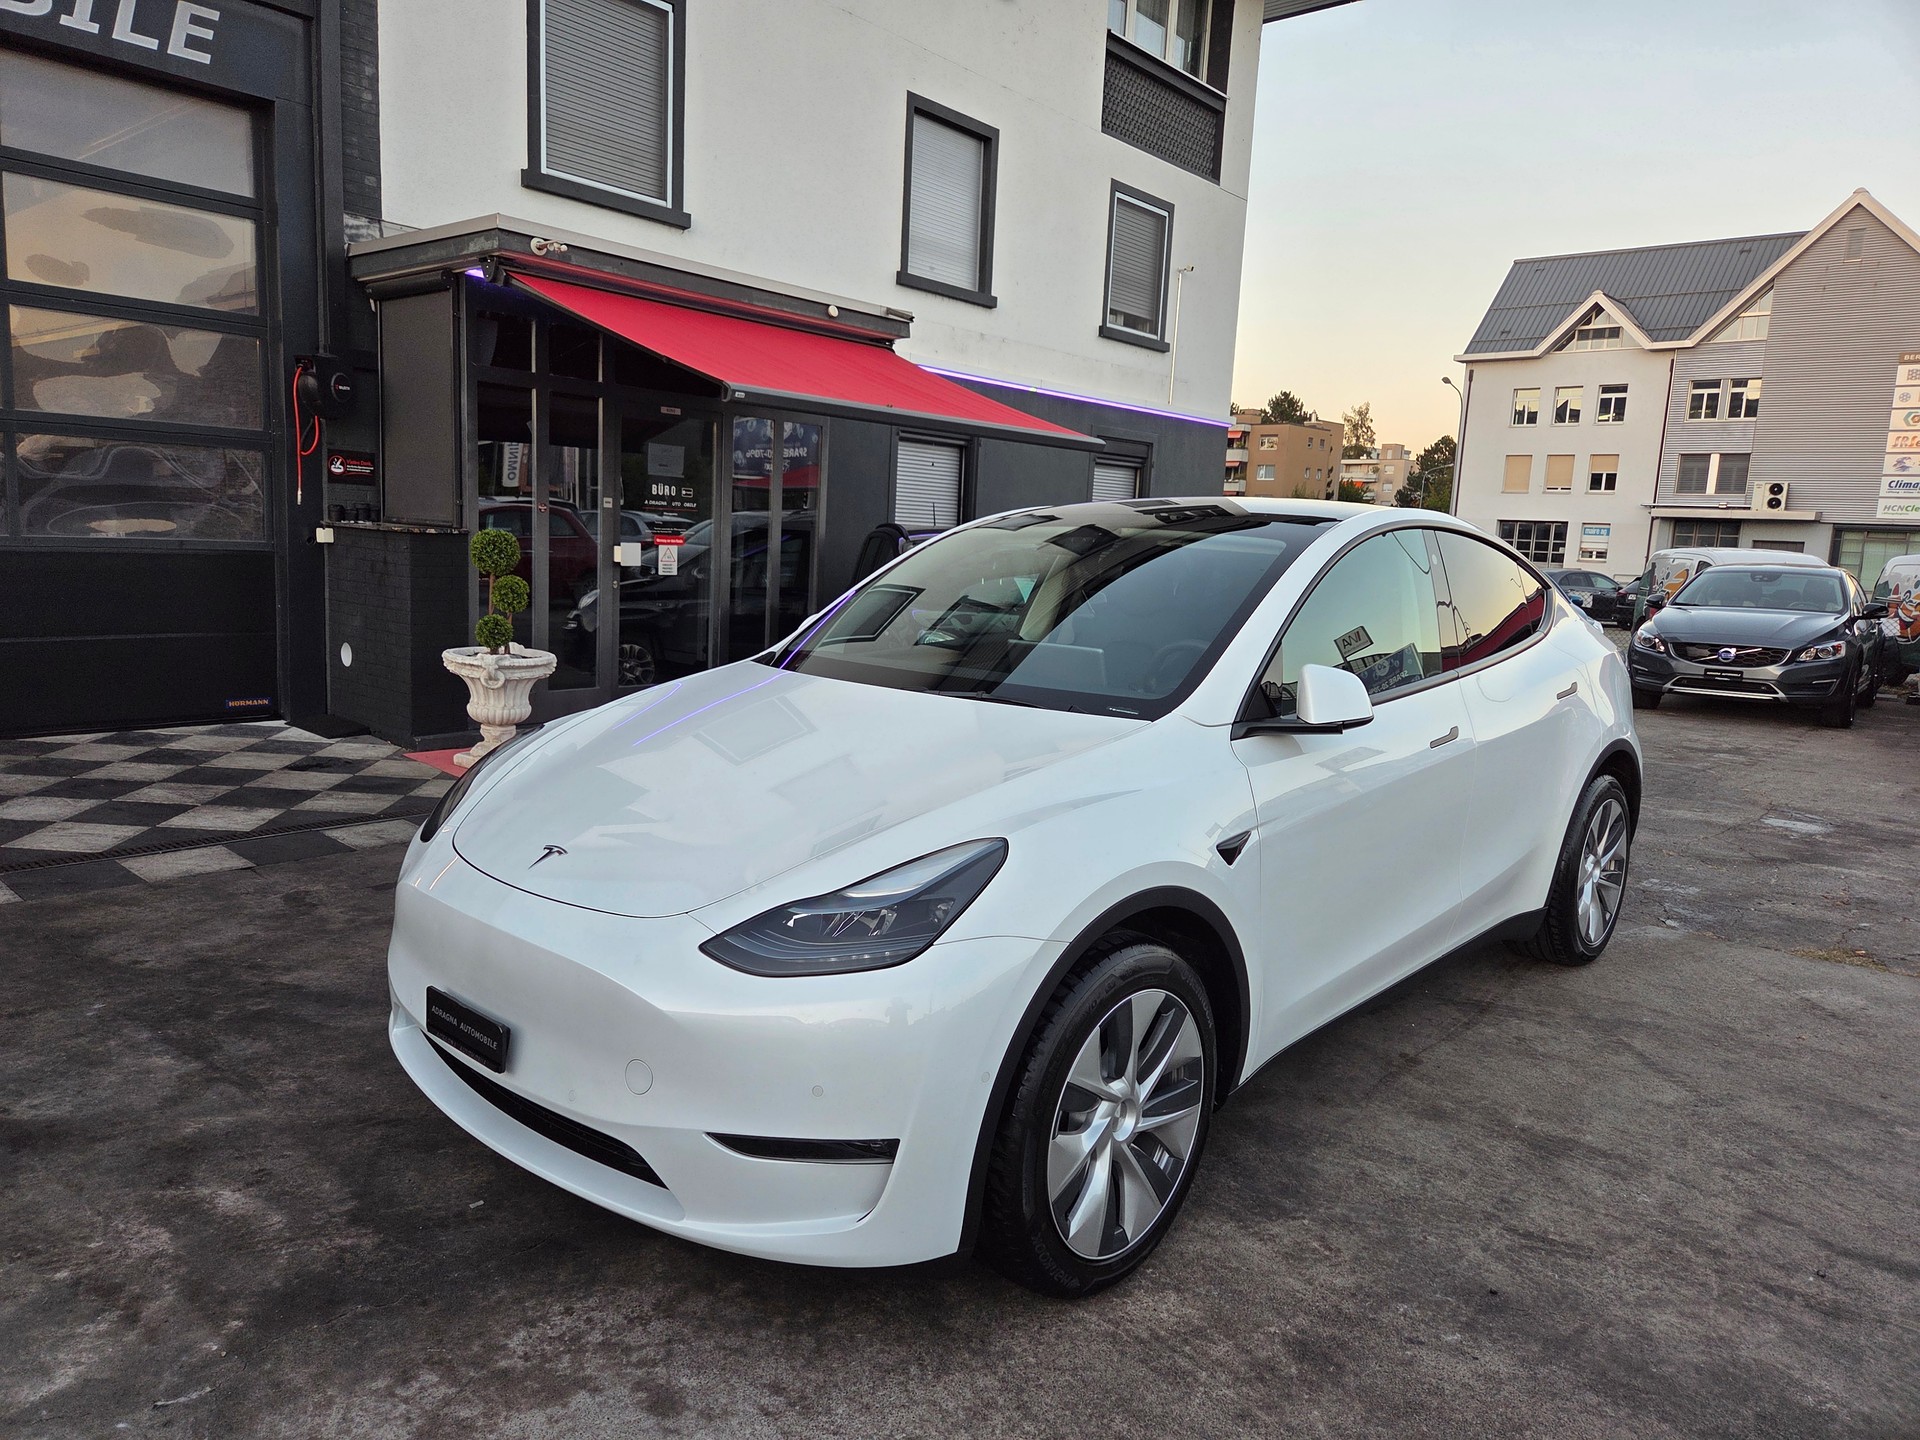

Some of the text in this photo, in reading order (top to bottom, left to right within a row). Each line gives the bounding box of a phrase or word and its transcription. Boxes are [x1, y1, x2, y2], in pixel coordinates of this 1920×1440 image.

[651, 482, 677, 497] BÜRO
[431, 1005, 458, 1027] ADRAGNA
[459, 1022, 498, 1050] AUTOMOBILE
